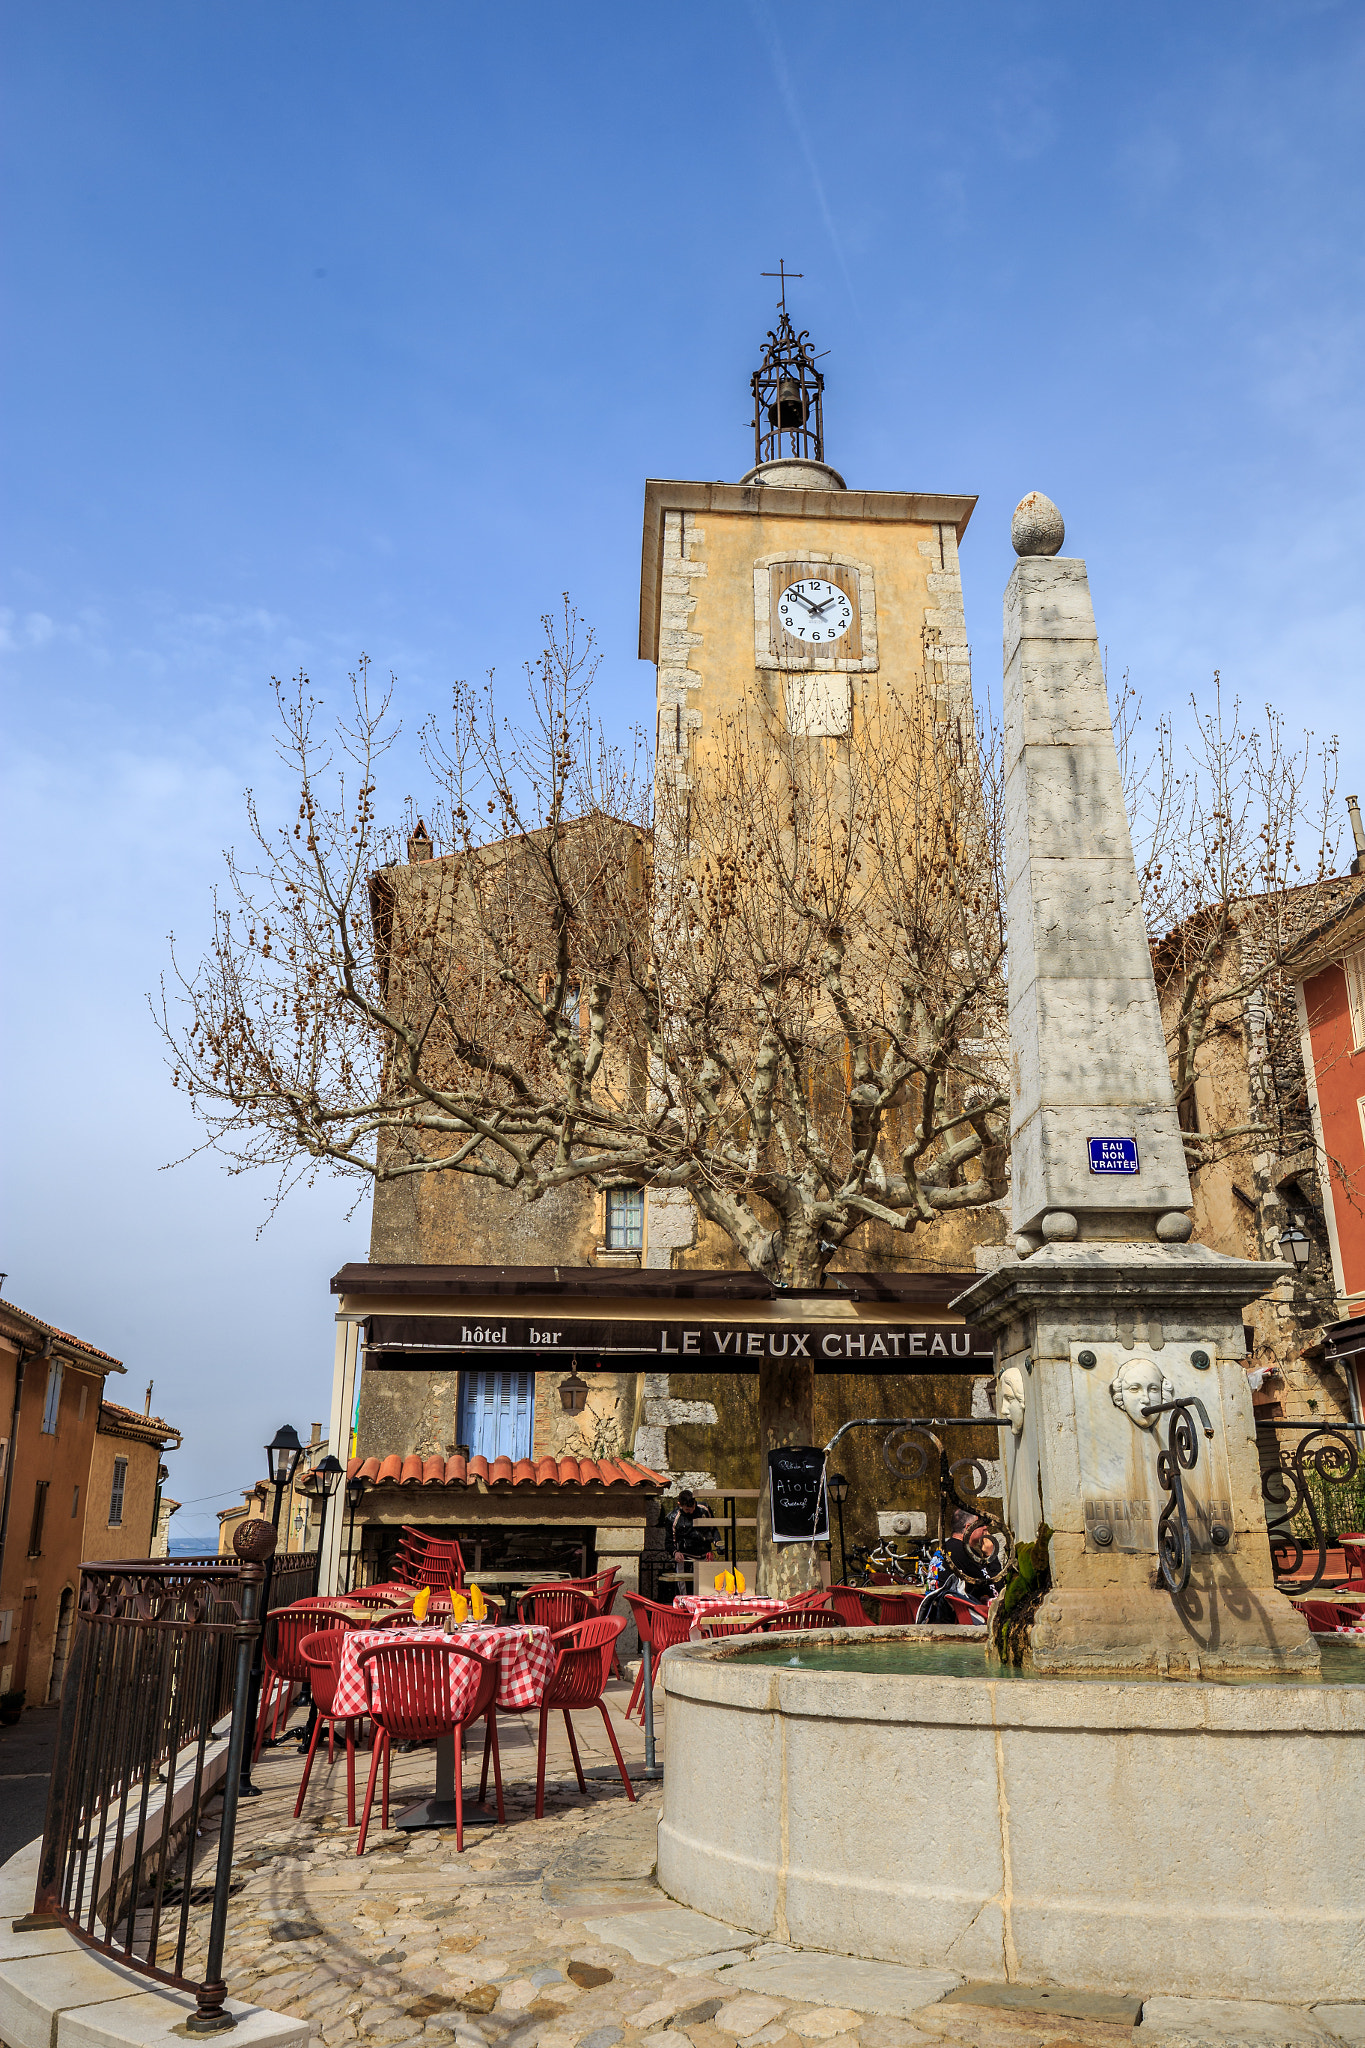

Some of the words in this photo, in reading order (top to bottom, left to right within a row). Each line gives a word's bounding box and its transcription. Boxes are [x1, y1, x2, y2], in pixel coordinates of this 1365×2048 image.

[795, 584, 805, 593] 11
[808, 582, 820, 590] 12
[826, 586, 832, 594] 1
[785, 593, 798, 603] 10
[838, 596, 845, 604] 2
[780, 605, 788, 614] 9
[842, 608, 850, 616] 3
[785, 618, 793, 626] 8
[838, 620, 846, 628] 4
[798, 628, 805, 636] 7
[812, 632, 820, 640] 6
[828, 629, 836, 638] 5
[1102, 1142, 1123, 1151] EAU
[1102, 1151, 1125, 1160] NON
[1092, 1160, 1136, 1169] TRAITÉE
[461, 1325, 507, 1343] hôtel
[529, 1327, 562, 1344] bar
[660, 1330, 701, 1355] LE
[713, 1331, 811, 1357] VIEUX
[821, 1332, 971, 1357] CHATEAU
